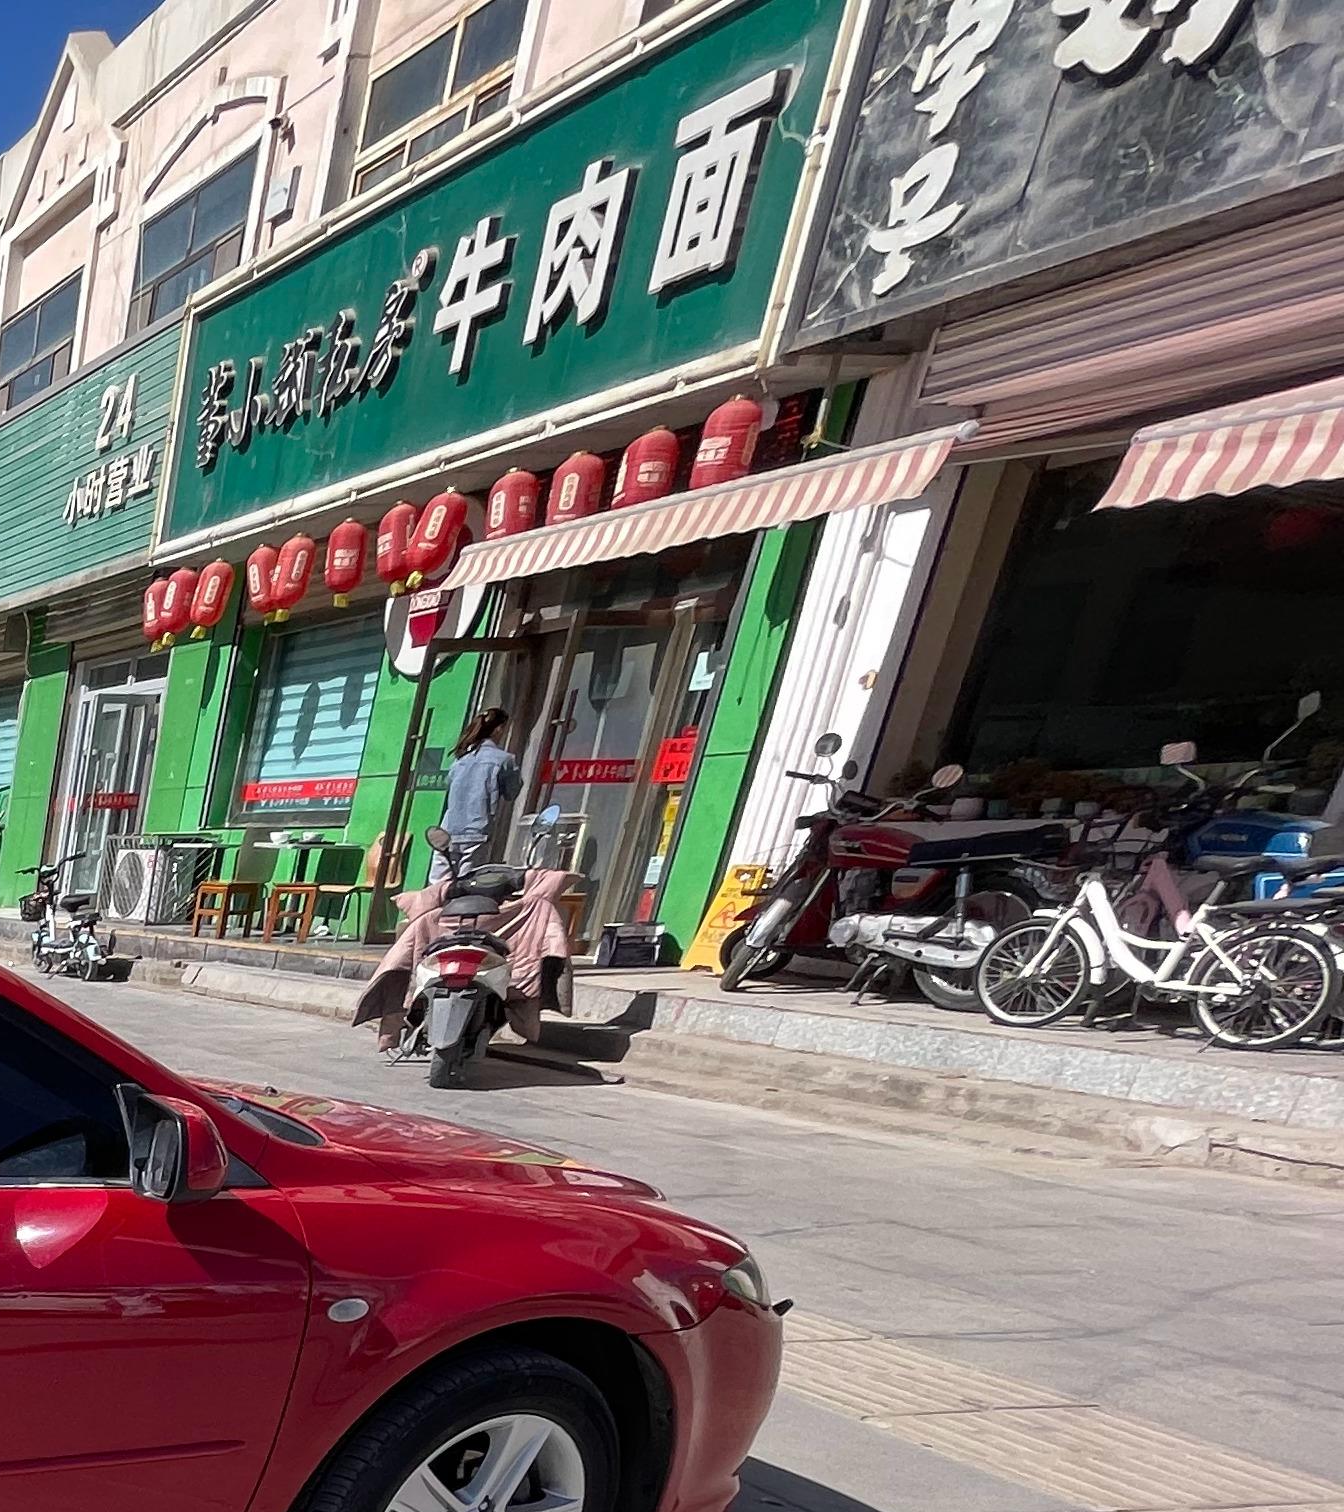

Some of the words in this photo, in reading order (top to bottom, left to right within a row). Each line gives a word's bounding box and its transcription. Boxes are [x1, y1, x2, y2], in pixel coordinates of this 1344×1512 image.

[434, 67, 783, 374] 牛肉面
[96, 372, 139, 451] 24
[63, 444, 155, 526] 小时营业
